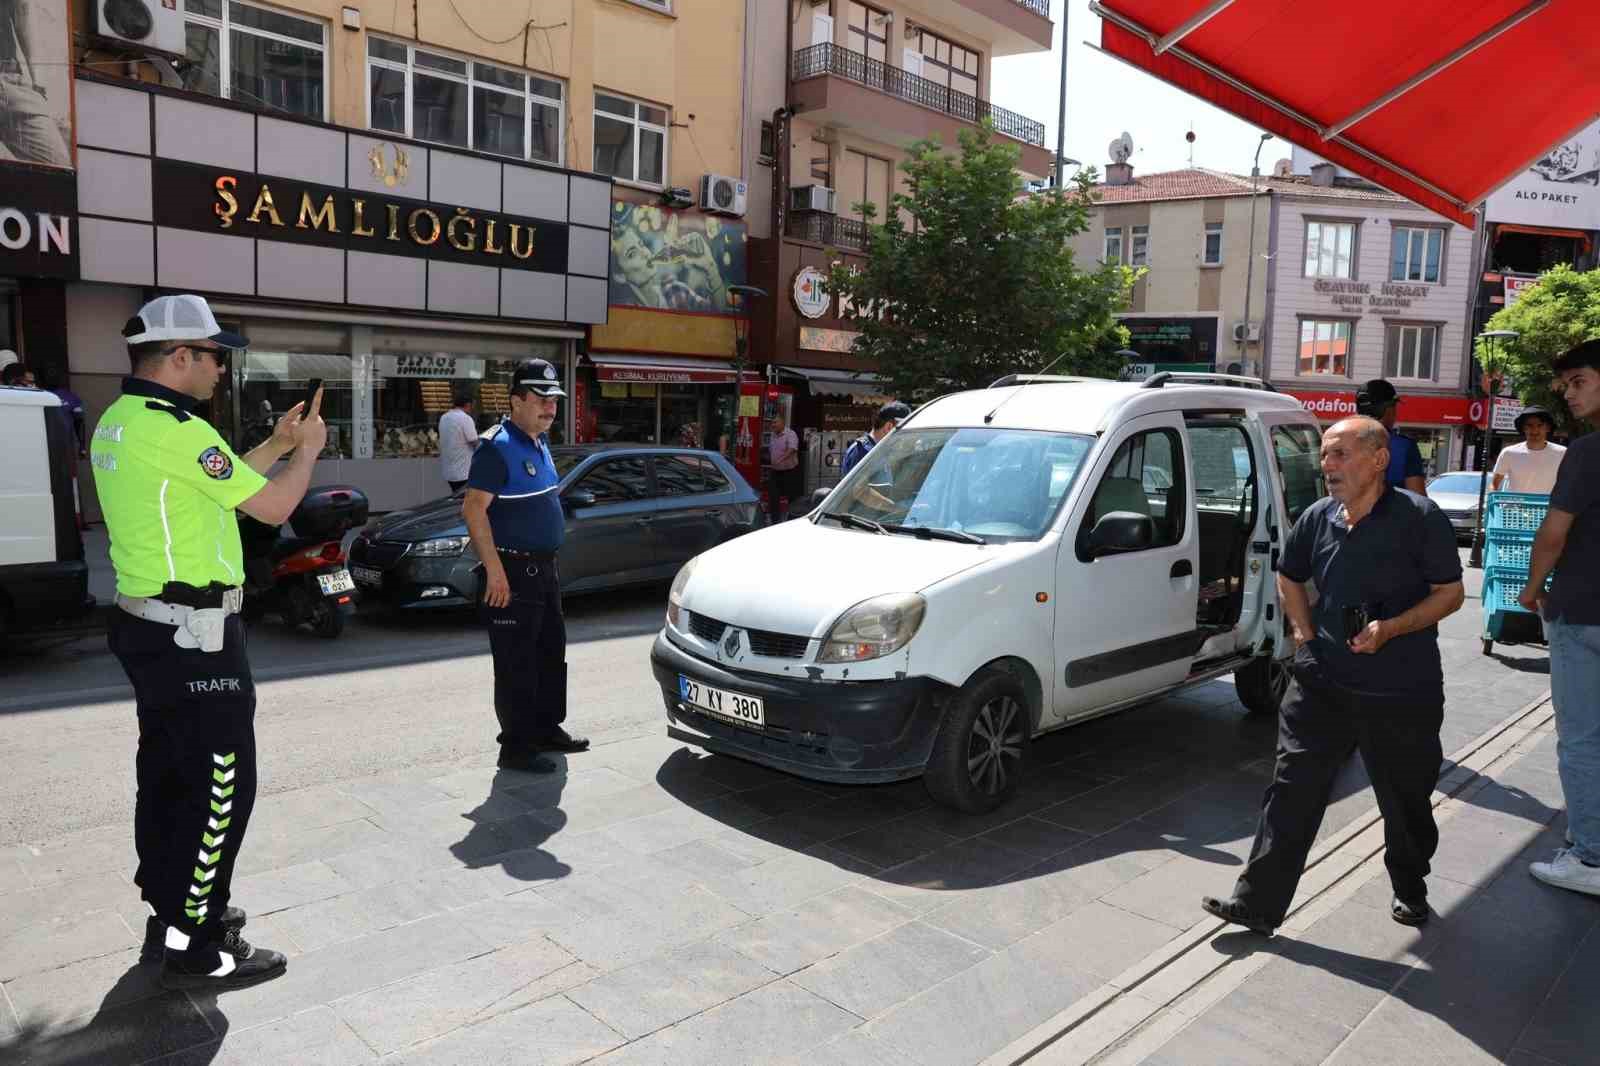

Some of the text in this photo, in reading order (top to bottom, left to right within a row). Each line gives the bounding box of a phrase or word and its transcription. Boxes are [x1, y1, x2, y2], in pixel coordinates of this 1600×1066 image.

[1515, 190, 1580, 205] ALO PAKET
[213, 176, 537, 259] ŞAMLIOĞLU
[1299, 398, 1358, 413] vodafon
[686, 682, 699, 703] 27
[732, 696, 759, 720] 380
